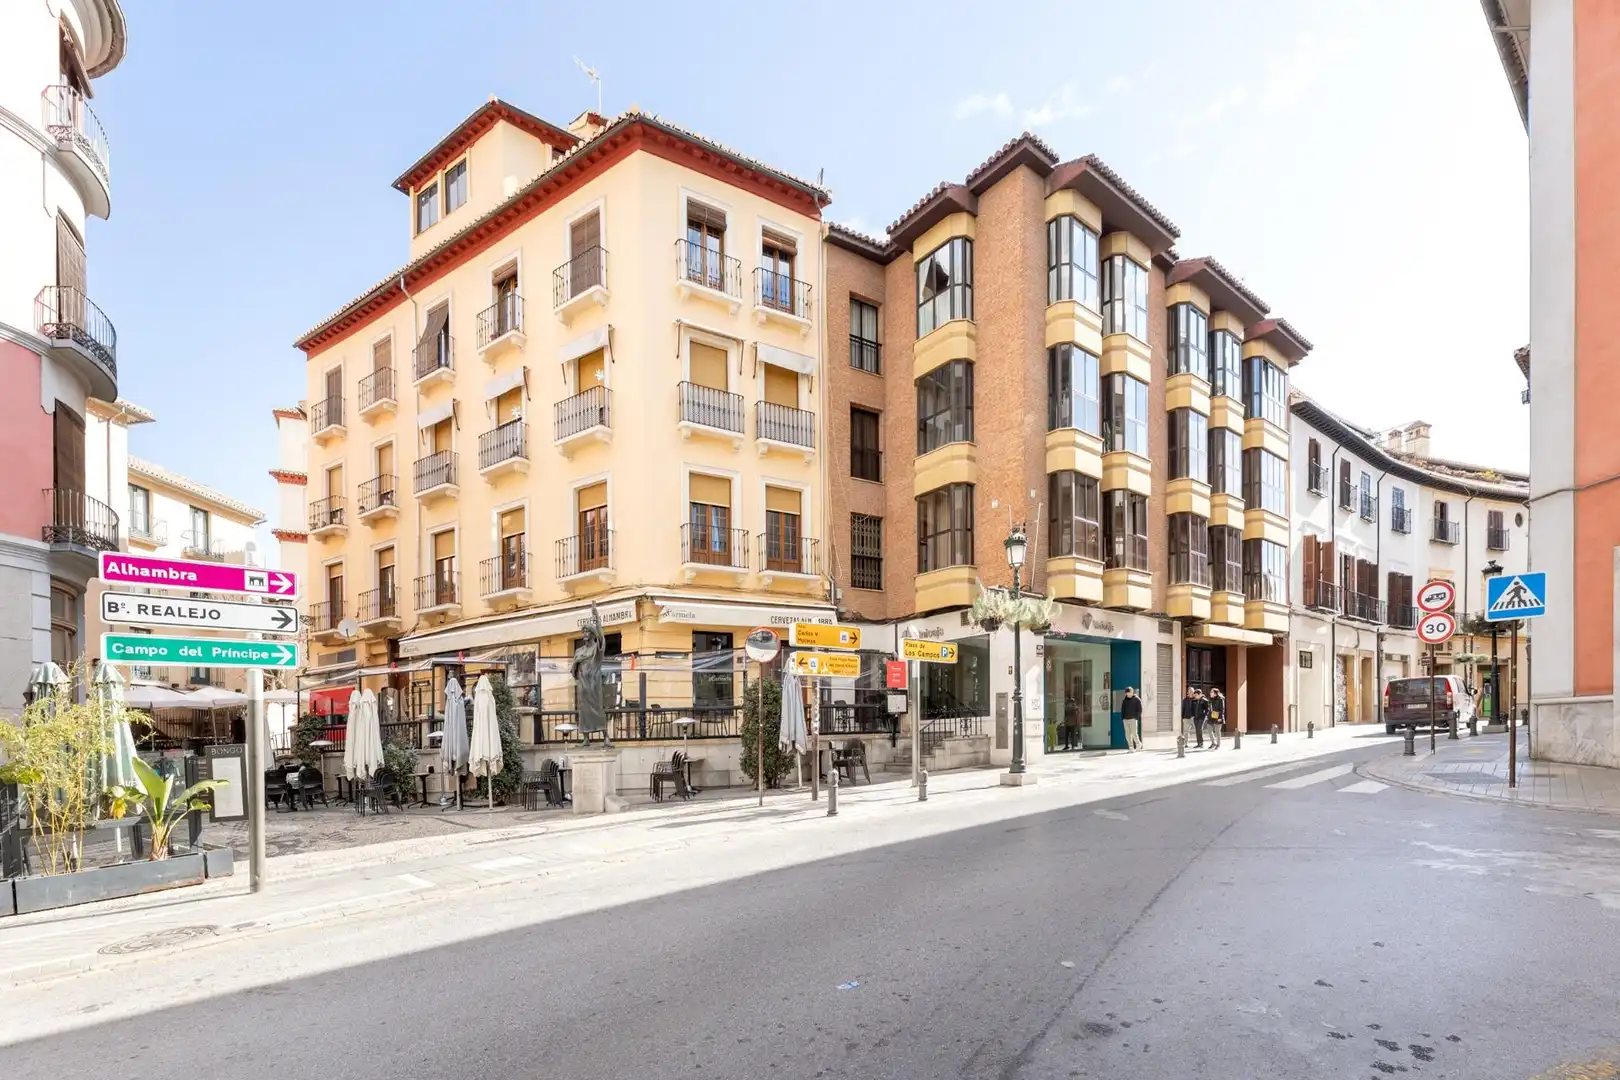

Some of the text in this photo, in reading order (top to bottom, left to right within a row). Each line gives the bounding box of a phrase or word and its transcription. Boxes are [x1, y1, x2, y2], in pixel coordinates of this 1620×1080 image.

[107, 562, 197, 581] Alhambra
[138, 603, 221, 620] REALEJO
[1426, 623, 1446, 634] 30
[112, 642, 168, 657] Campo
[179, 645, 203, 657] del
[917, 651, 940, 659] Campos
[211, 747, 243, 756] BONGO
